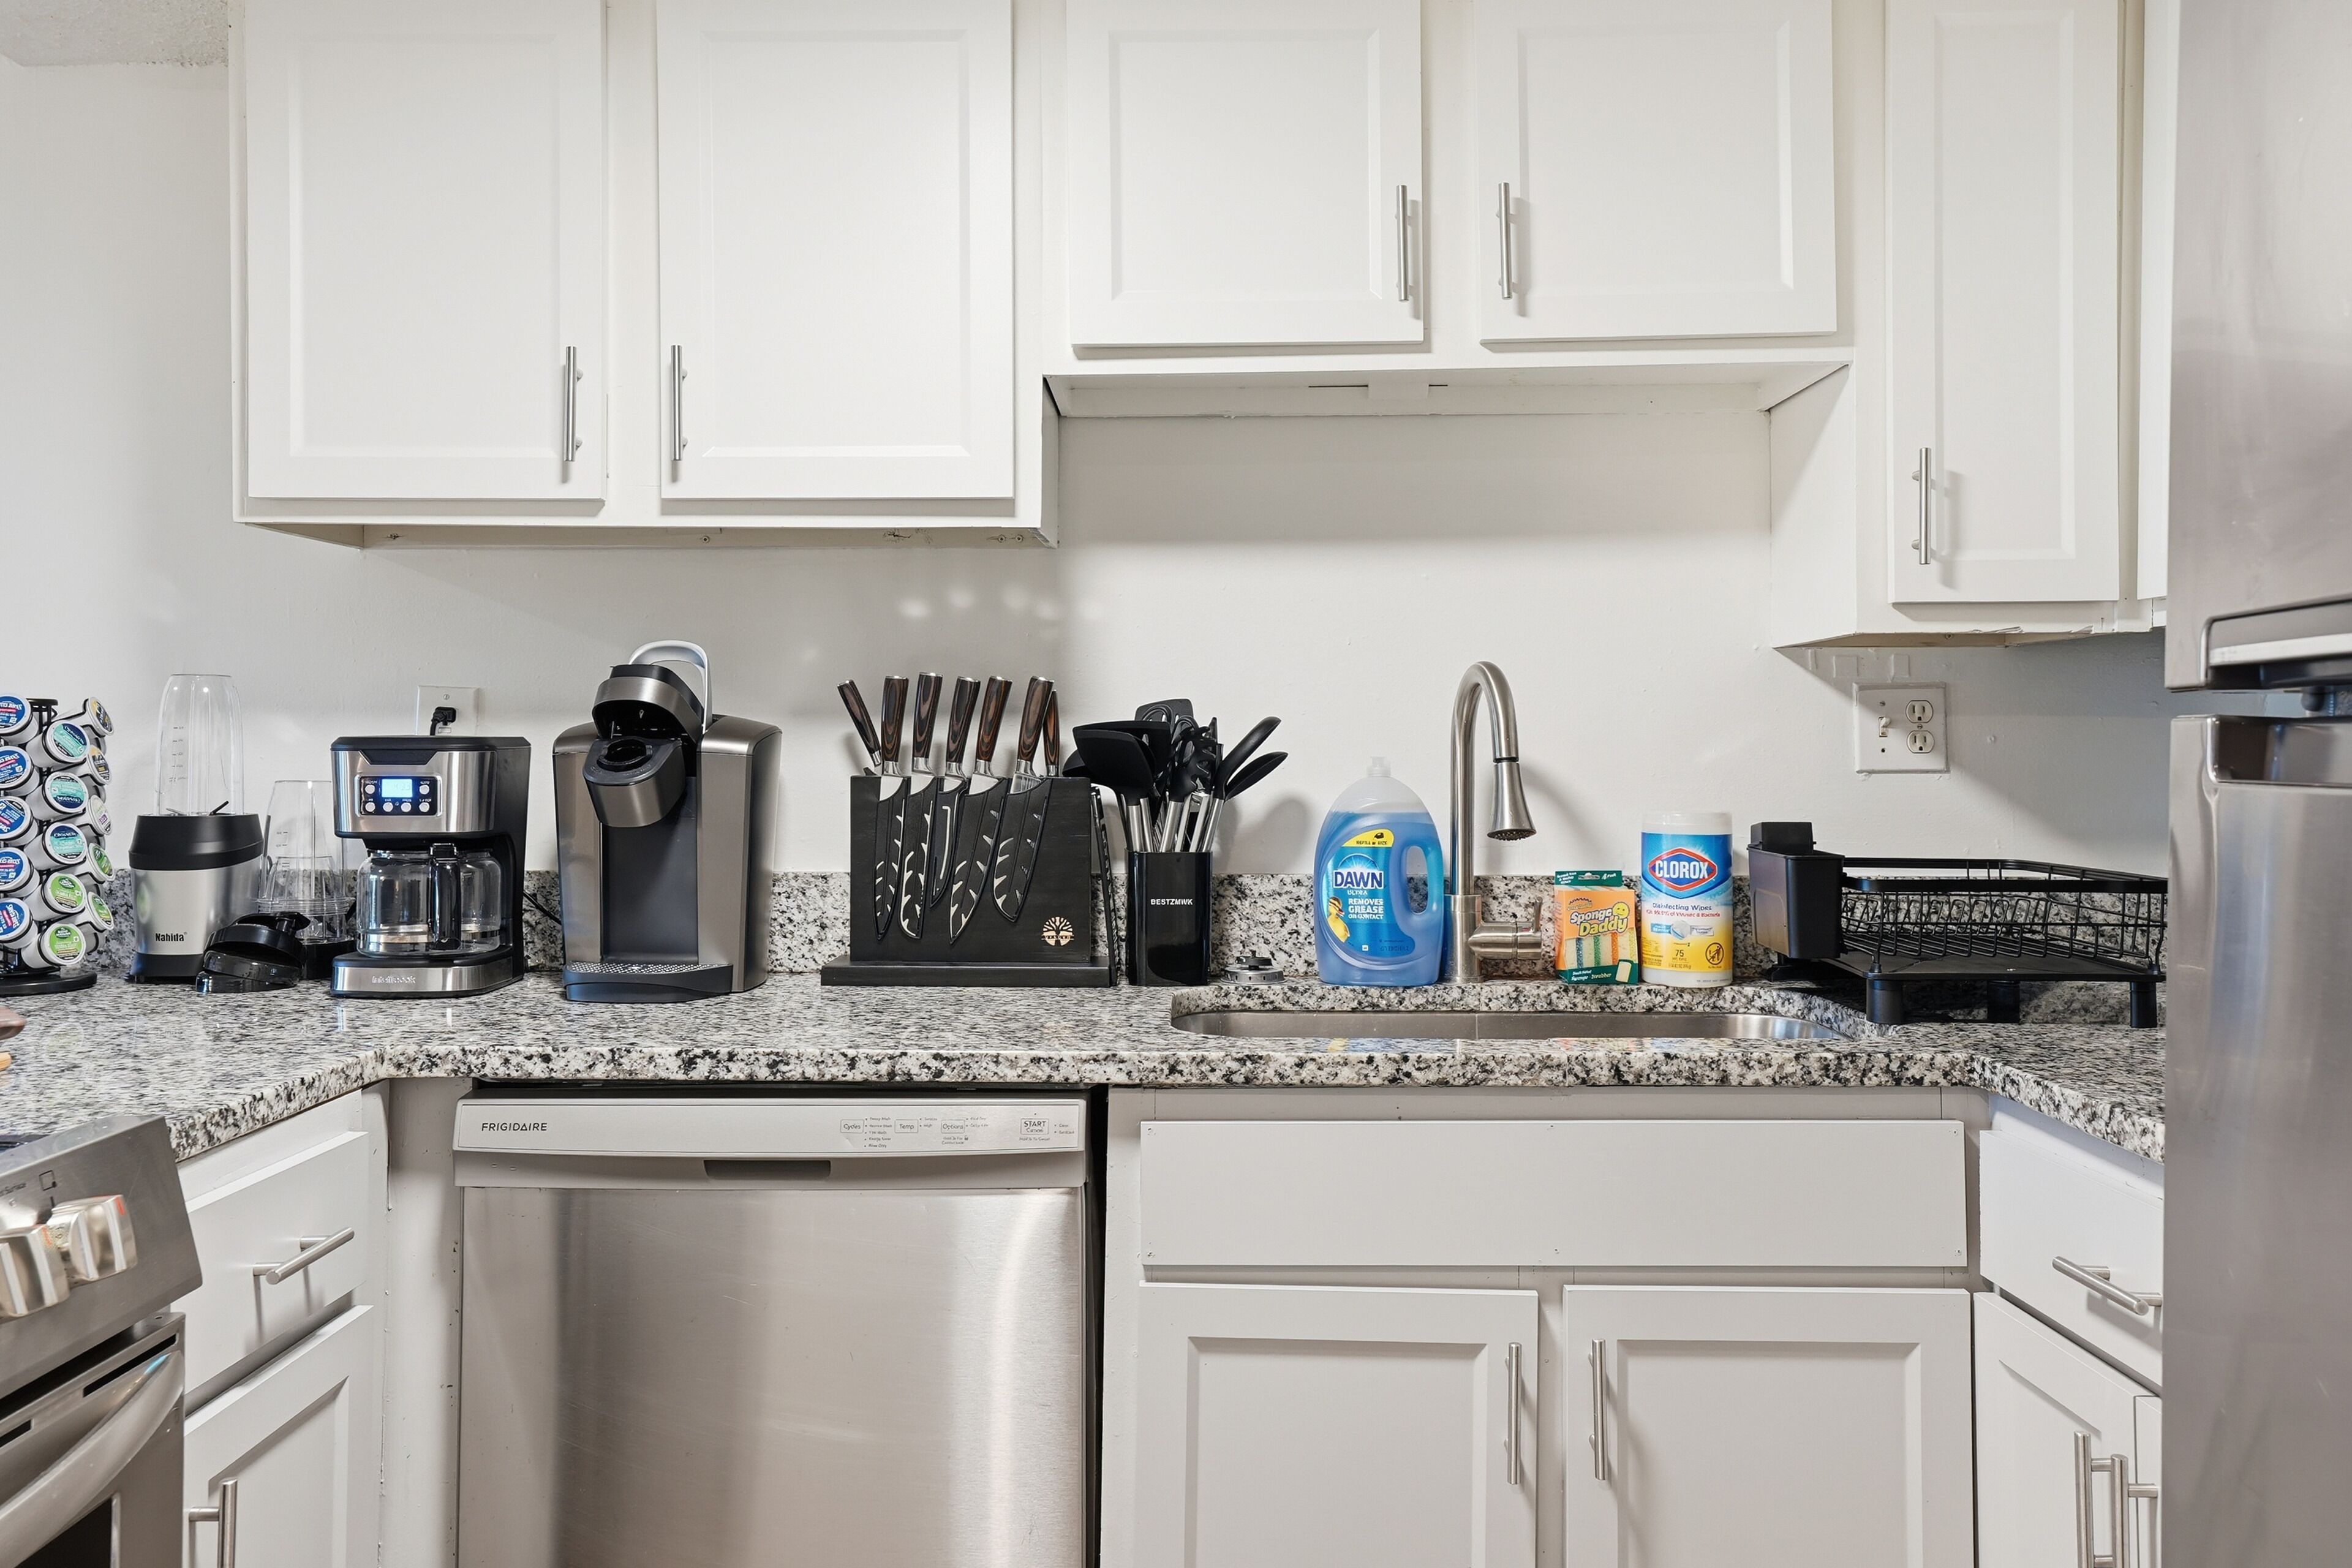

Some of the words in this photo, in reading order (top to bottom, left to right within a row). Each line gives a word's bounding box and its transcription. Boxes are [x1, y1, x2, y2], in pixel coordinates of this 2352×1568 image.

[1655, 860, 1709, 879] CLOROX
[1334, 871, 1383, 889] DAWN
[1348, 905, 1384, 914] GREASE
[1653, 902, 1689, 911] Disinfecting
[1570, 908, 1613, 925] Sponge
[1578, 916, 1628, 937] Daddy
[155, 933, 184, 941] Nahida
[481, 1123, 548, 1131] FRIGIDAIRE
